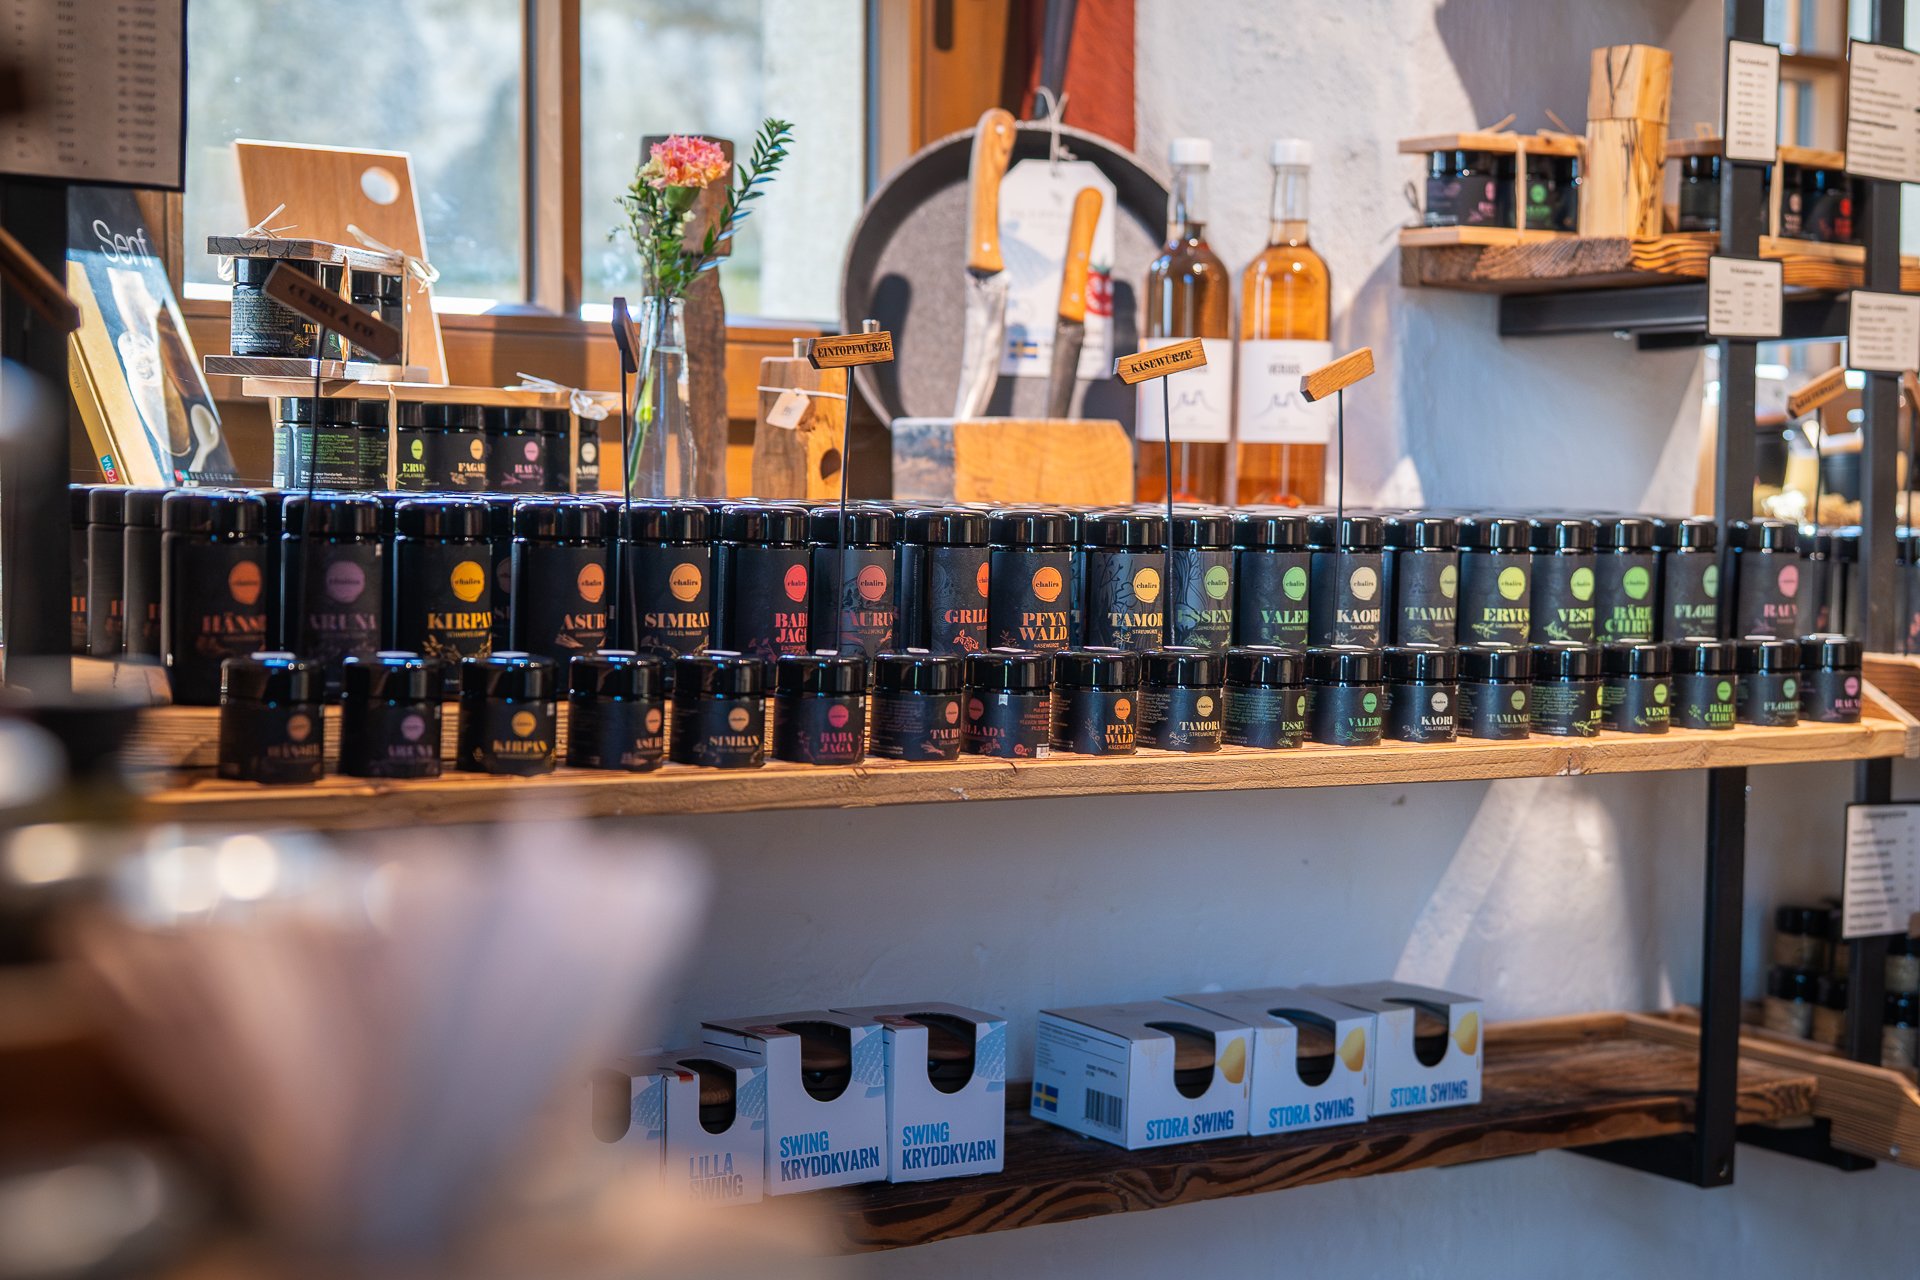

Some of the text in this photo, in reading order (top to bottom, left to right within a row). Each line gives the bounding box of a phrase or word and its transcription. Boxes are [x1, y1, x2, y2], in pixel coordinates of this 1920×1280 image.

[817, 341, 891, 358] EINTOPFWÜRZE
[1130, 349, 1193, 374] KÄSEWÜRZE
[1023, 612, 1067, 627] PFYN
[1018, 627, 1068, 641] WALD
[1106, 724, 1134, 734] PFYN
[1421, 715, 1453, 725] KAORI
[820, 732, 853, 743] BABA
[820, 743, 853, 753] JAGA
[1105, 733, 1134, 744] WALD
[1390, 1080, 1468, 1108] STORA SWING
[1146, 1109, 1234, 1141] STORA SWING
[1269, 1097, 1354, 1128] STORA SWING
[780, 1130, 829, 1158] SWING
[902, 1121, 950, 1147] SWING
[689, 1153, 733, 1179] LILLA
[780, 1146, 880, 1182] KRYDDKVARN
[902, 1139, 996, 1170] KRYDDKVARN
